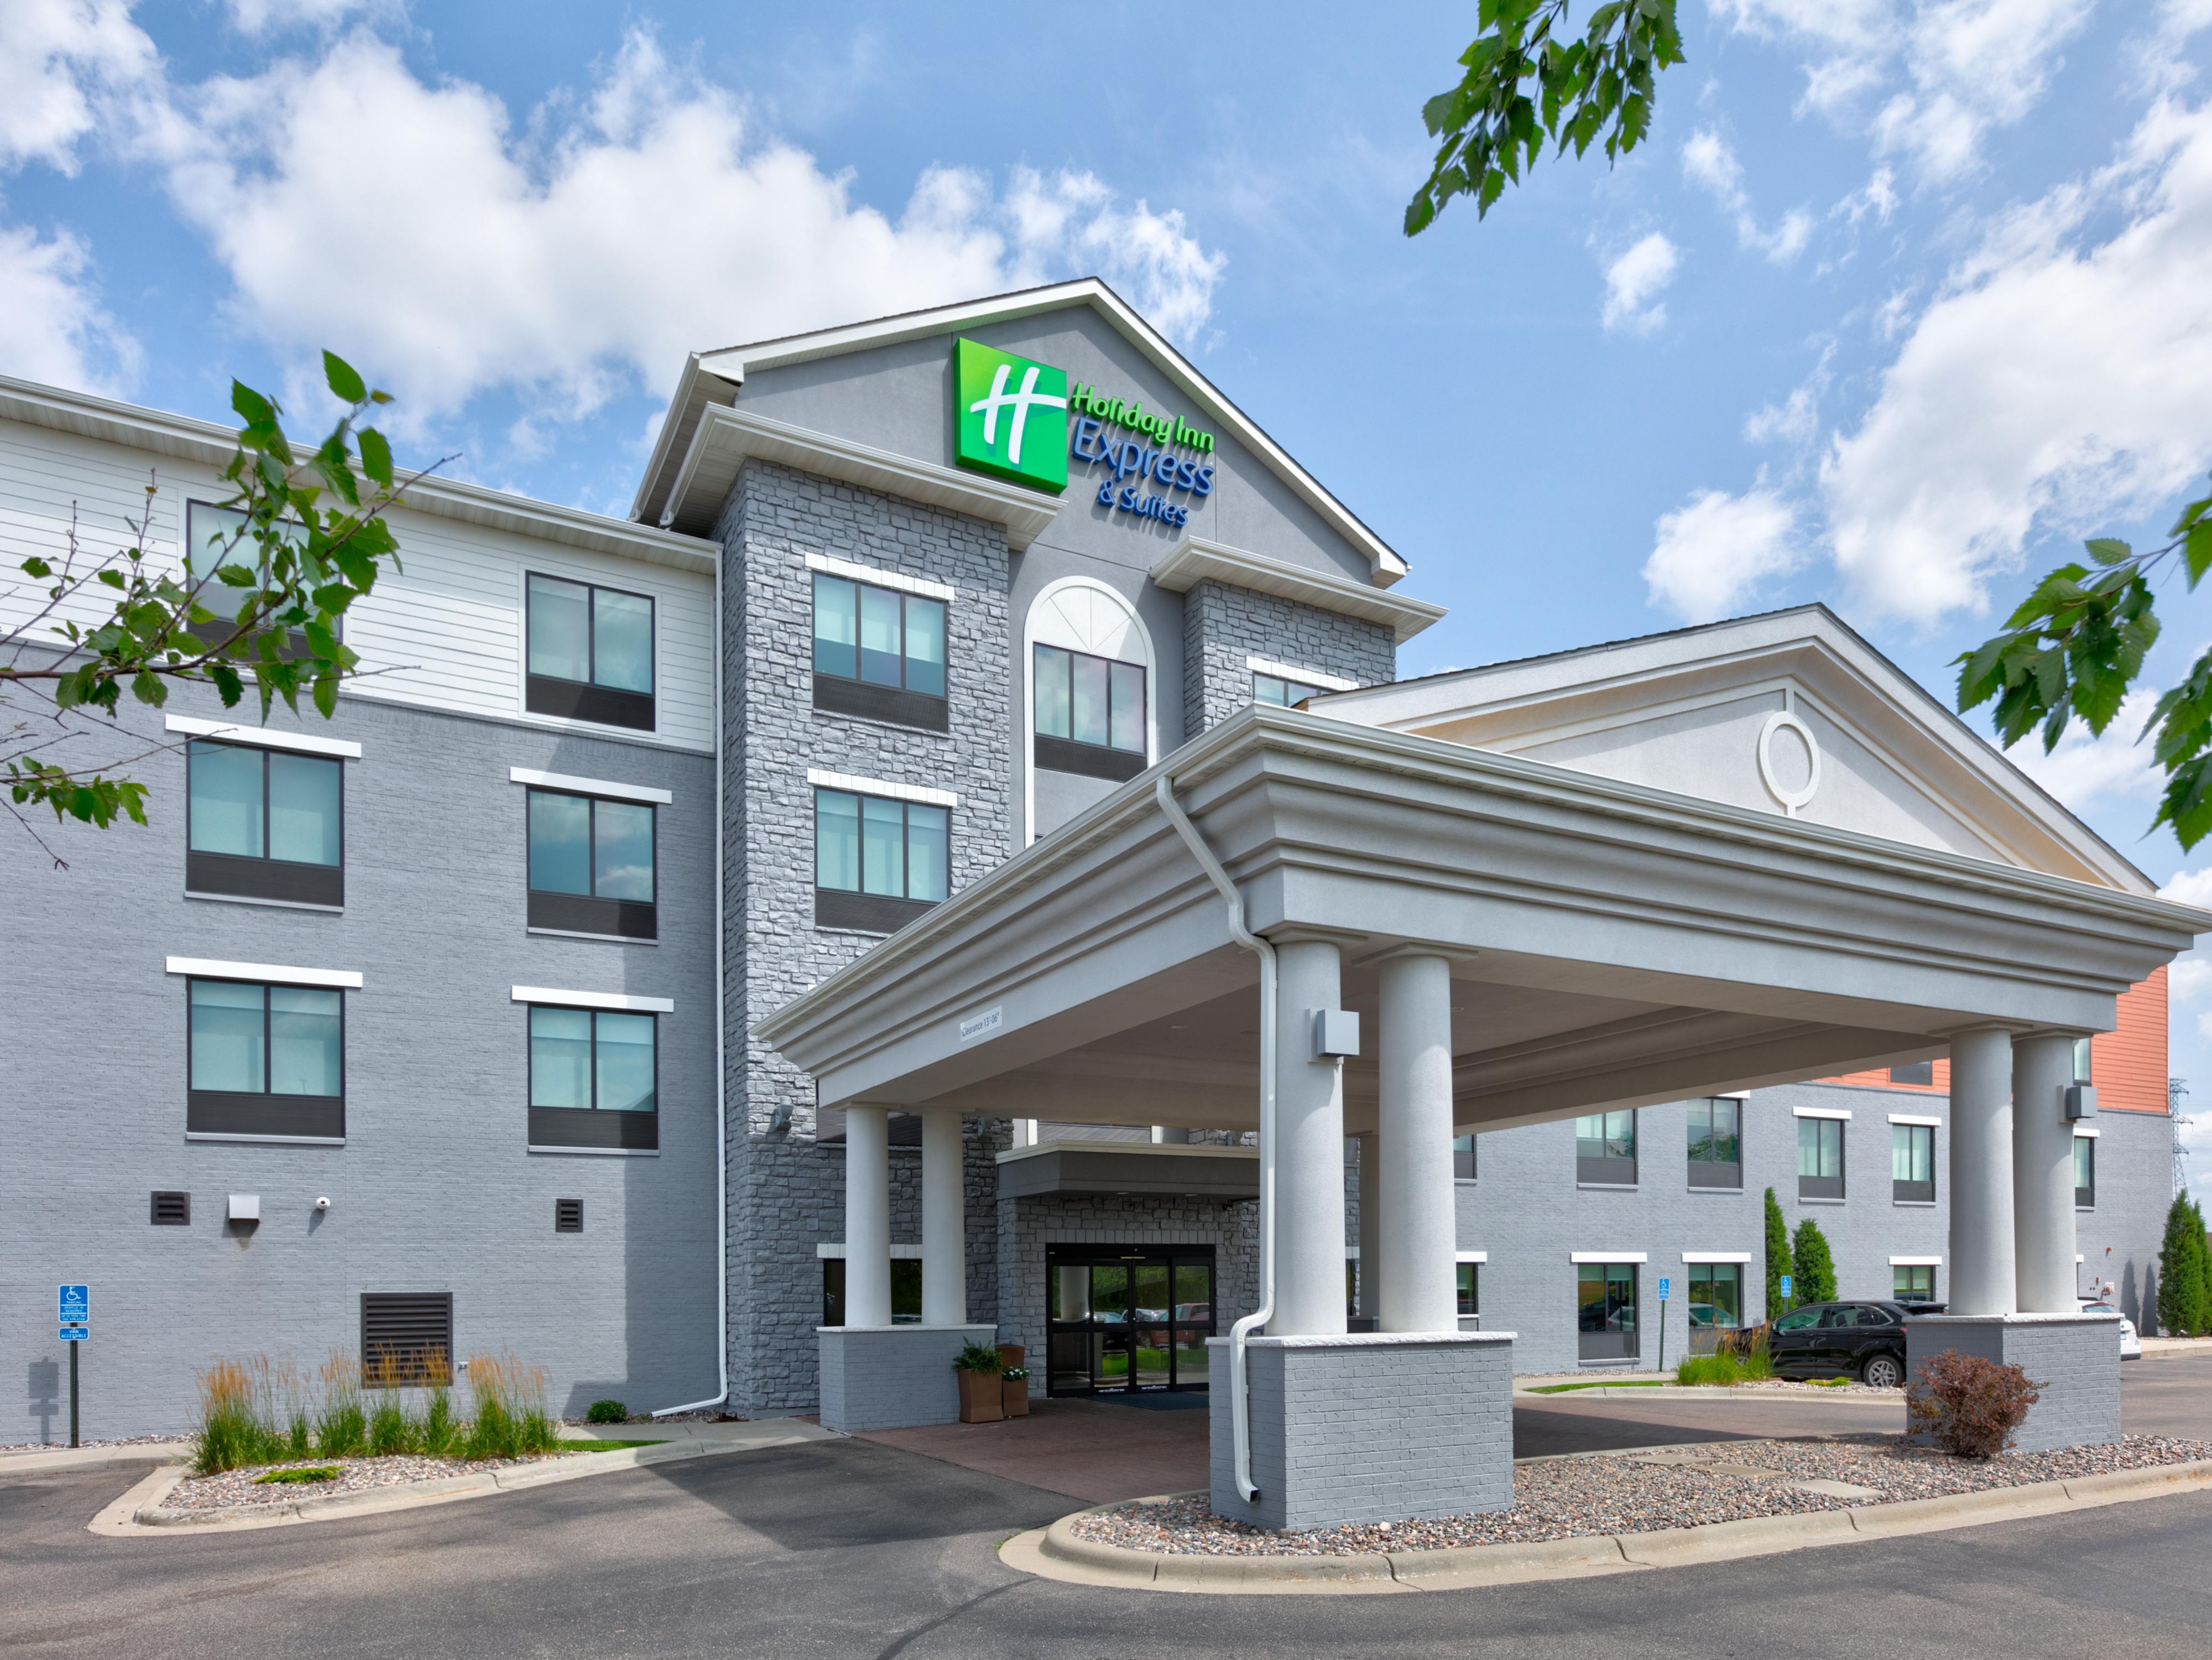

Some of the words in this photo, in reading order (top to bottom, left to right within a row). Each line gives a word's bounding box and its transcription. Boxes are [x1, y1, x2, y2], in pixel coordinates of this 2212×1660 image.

[1070, 381, 1172, 446] Holiday
[1173, 415, 1214, 455] Inn
[1072, 417, 1215, 497] Express
[1097, 479, 1115, 508] &
[1118, 485, 1190, 528] Suites
[962, 1022, 983, 1037] Clearance
